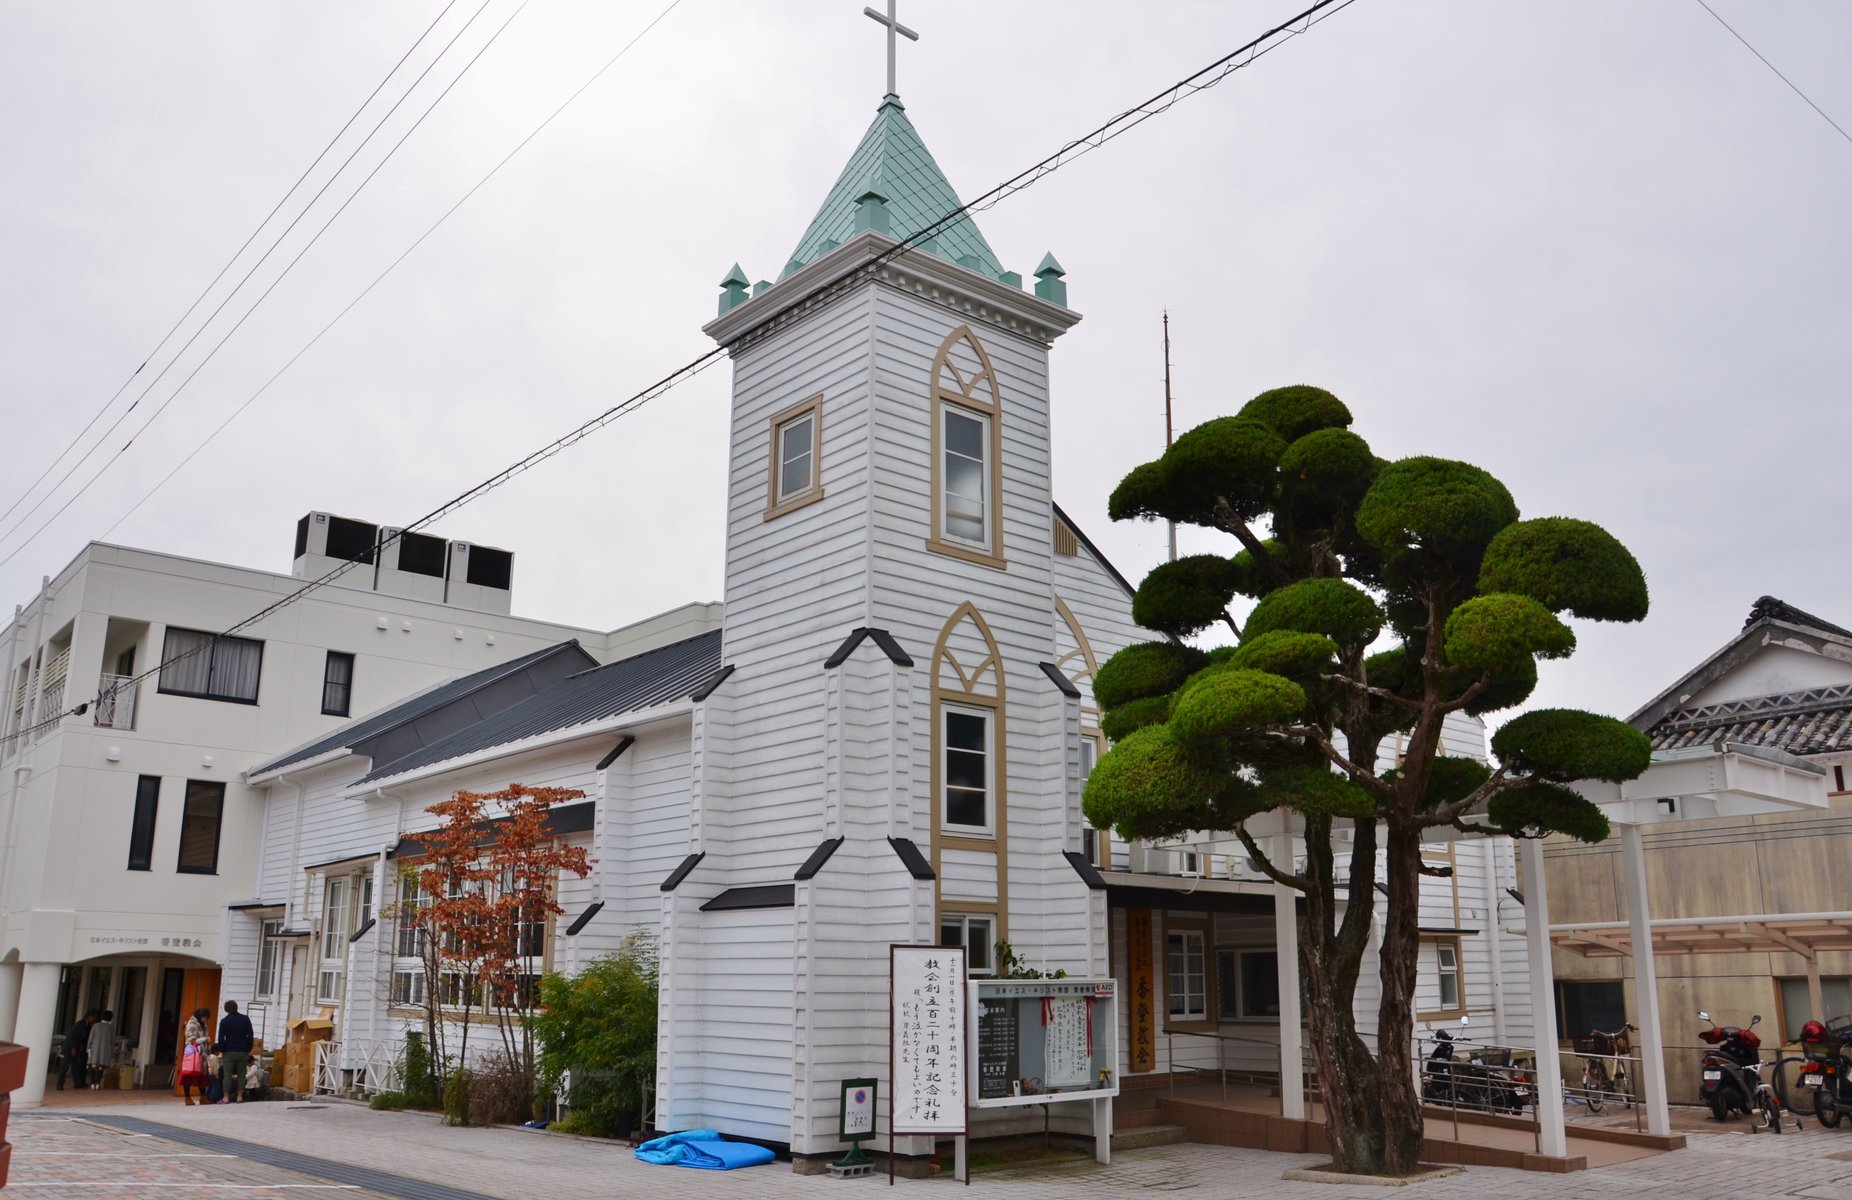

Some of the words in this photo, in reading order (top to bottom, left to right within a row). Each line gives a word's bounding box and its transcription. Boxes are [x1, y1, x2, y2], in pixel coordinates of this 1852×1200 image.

[923, 959, 942, 1122] 教会創立百二十周年記念礼拝
